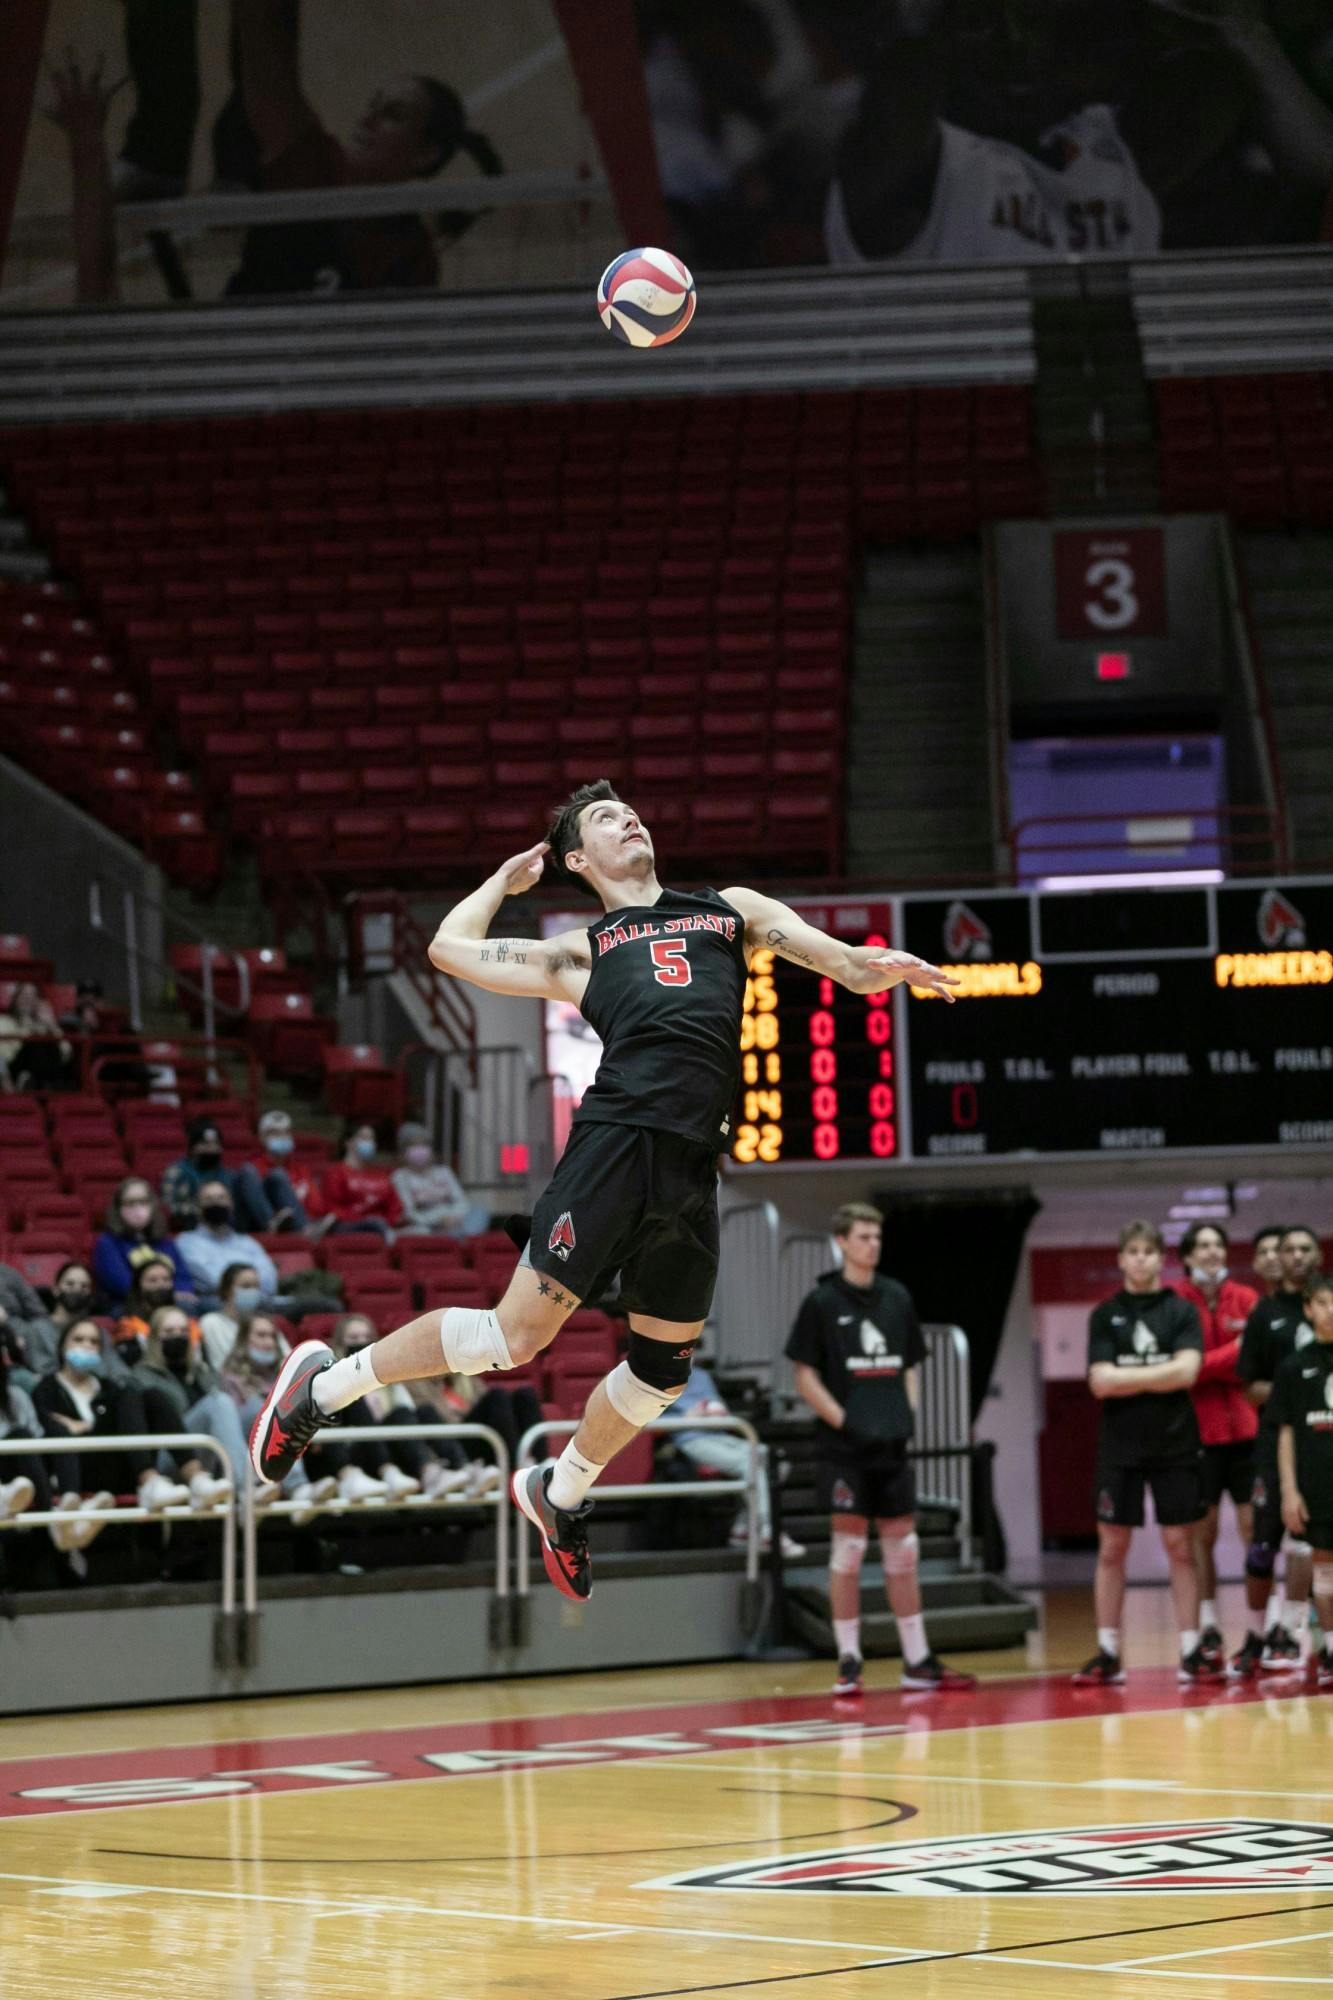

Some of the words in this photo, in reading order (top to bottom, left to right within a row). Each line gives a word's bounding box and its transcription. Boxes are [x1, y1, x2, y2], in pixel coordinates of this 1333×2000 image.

[1086, 561, 1137, 630] 3
[595, 922, 660, 957] BALL
[664, 914, 736, 942] STATE
[766, 929, 813, 965] Family
[650, 938, 692, 987] 5
[1216, 950, 1333, 988] PIONEERS
[809, 1010, 835, 1047] 0
[866, 1008, 891, 1045] 0
[743, 1053, 781, 1085] 11
[810, 1047, 837, 1084] 0
[745, 1089, 782, 1122] 14
[812, 1085, 838, 1122] 0
[869, 1082, 894, 1120] 0
[951, 1082, 978, 1128] 0
[734, 1123, 783, 1163] 22
[813, 1122, 840, 1160] 0
[870, 1120, 896, 1157] 0
[910, 1842, 1055, 1862] 1946
